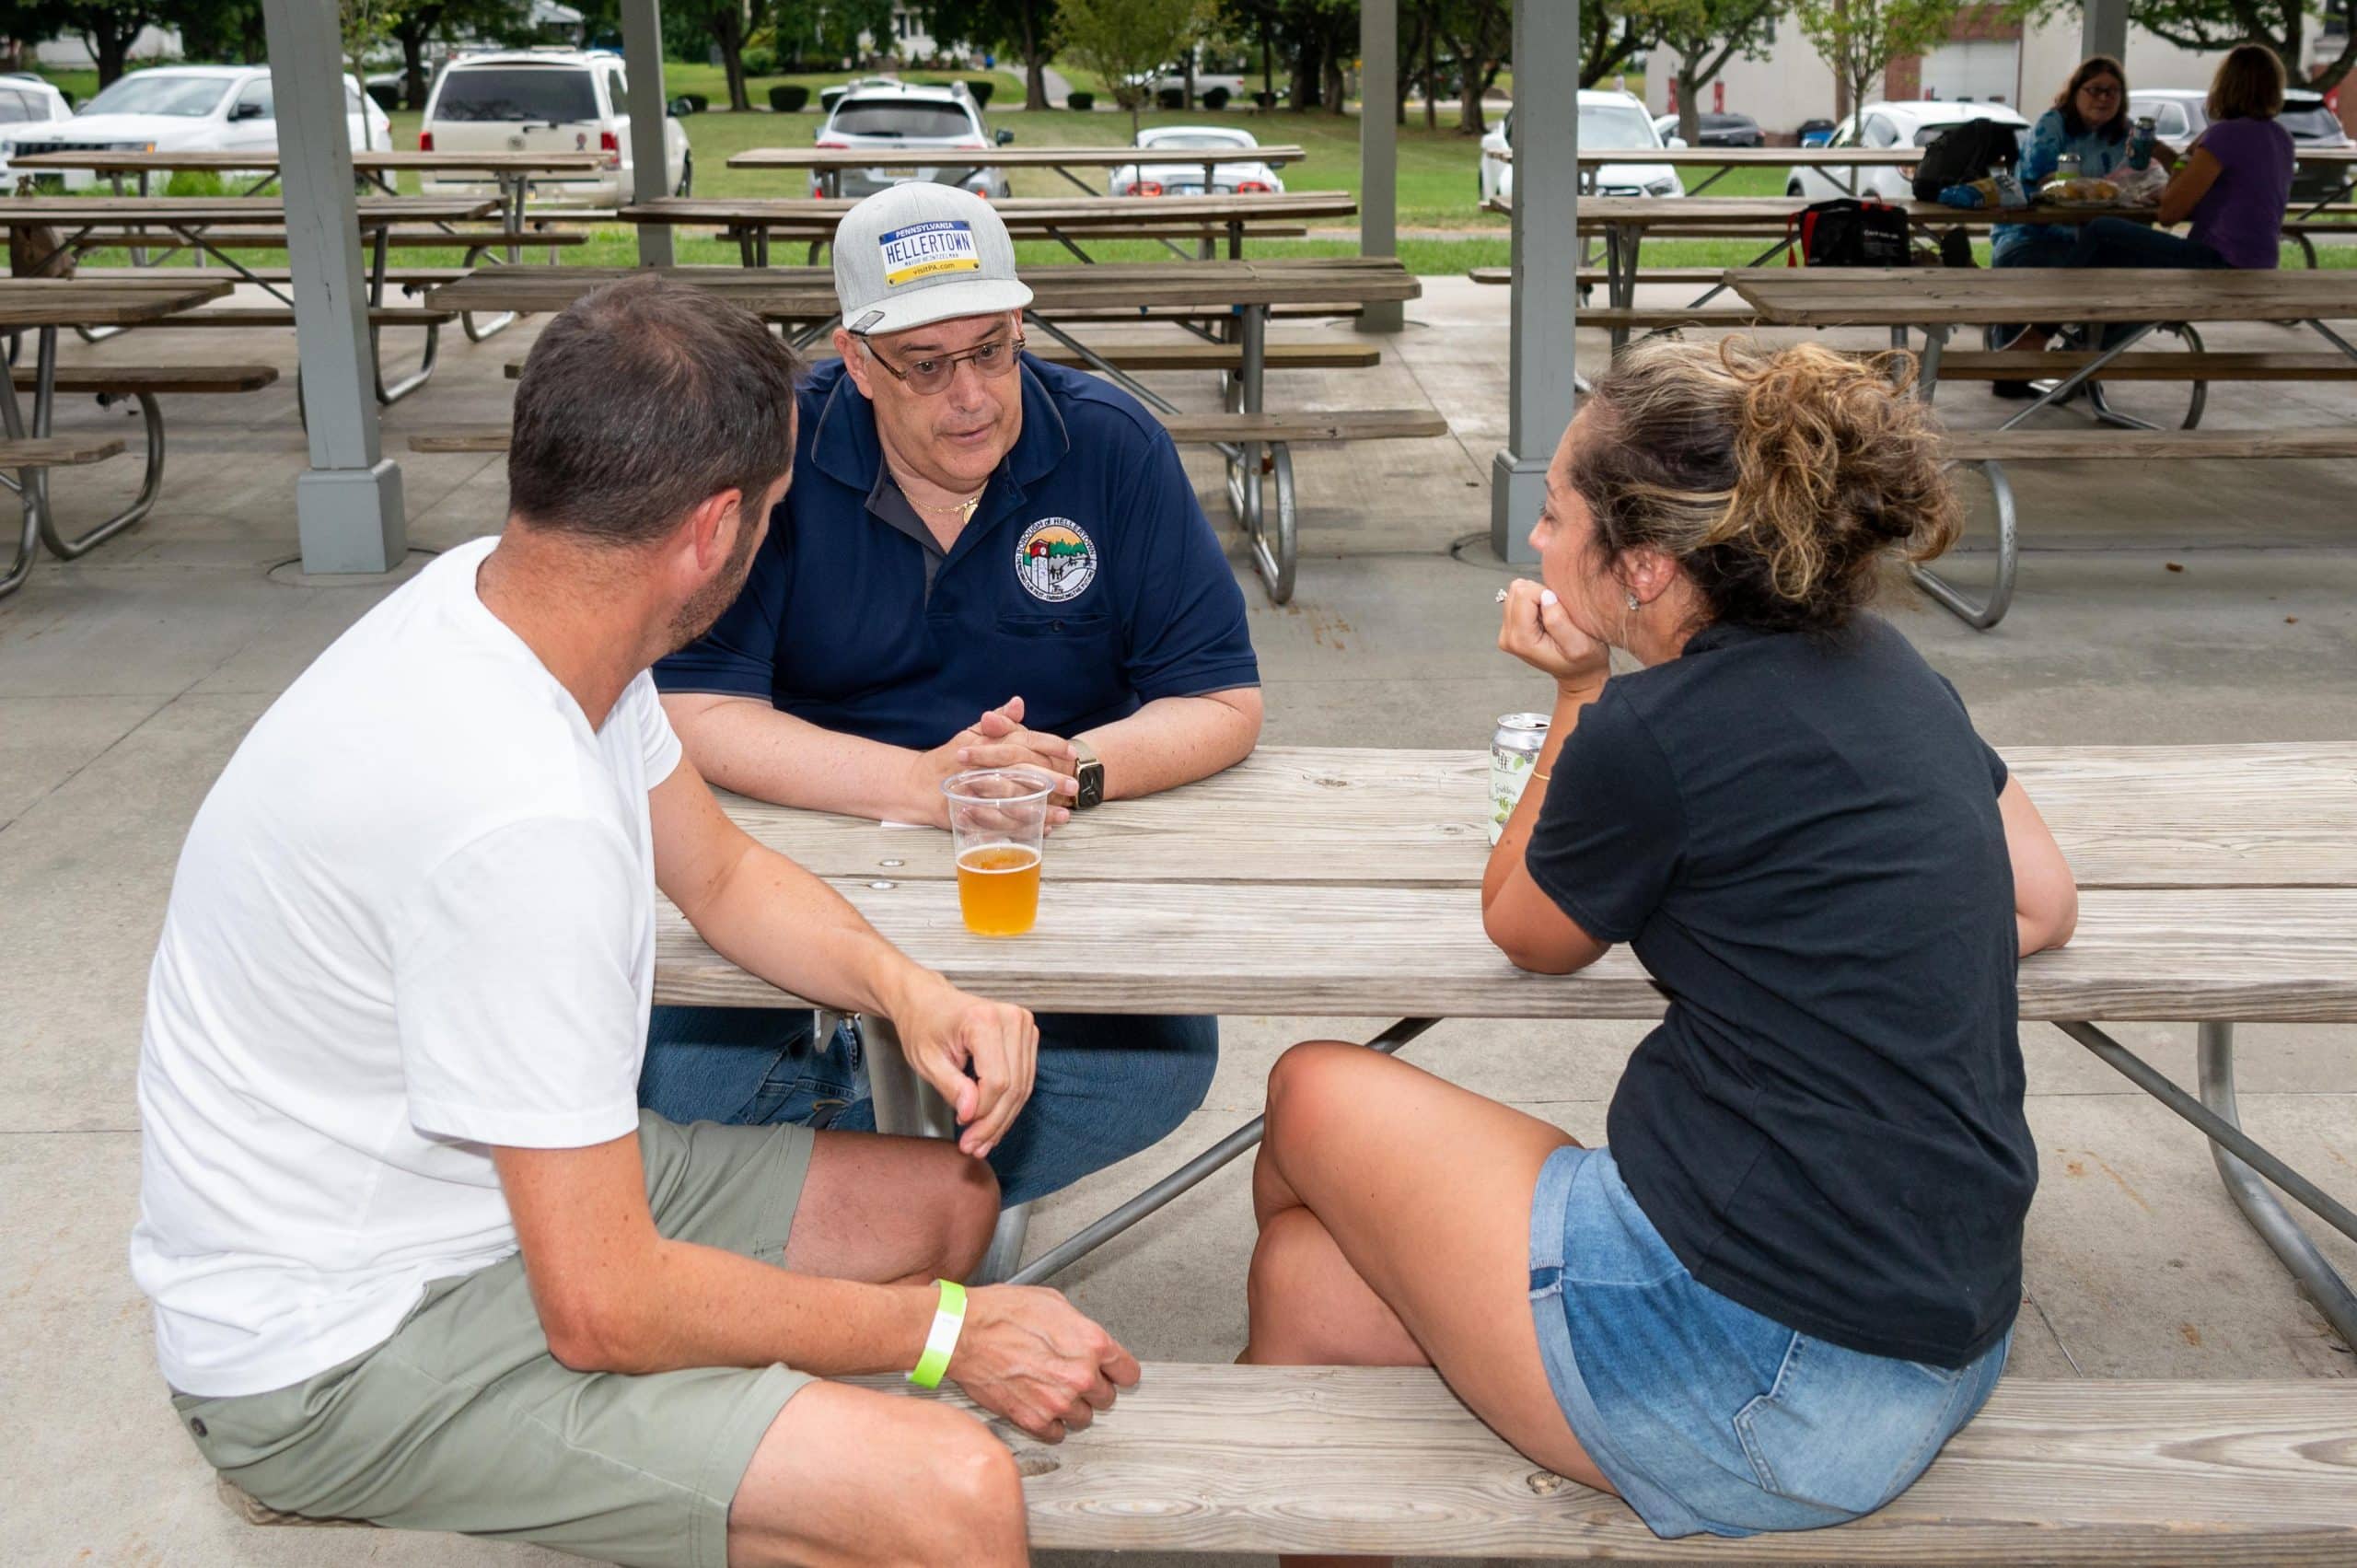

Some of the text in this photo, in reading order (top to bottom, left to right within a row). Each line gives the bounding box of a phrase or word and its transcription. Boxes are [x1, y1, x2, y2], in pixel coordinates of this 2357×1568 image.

[896, 222, 954, 238] PENNSYLVANIA
[886, 233, 971, 264] HELLERTOWN
[913, 263, 955, 274] visitPA.com
[1017, 521, 1044, 553] BOROUGH
[1053, 518, 1096, 555] HELLERTOWN
